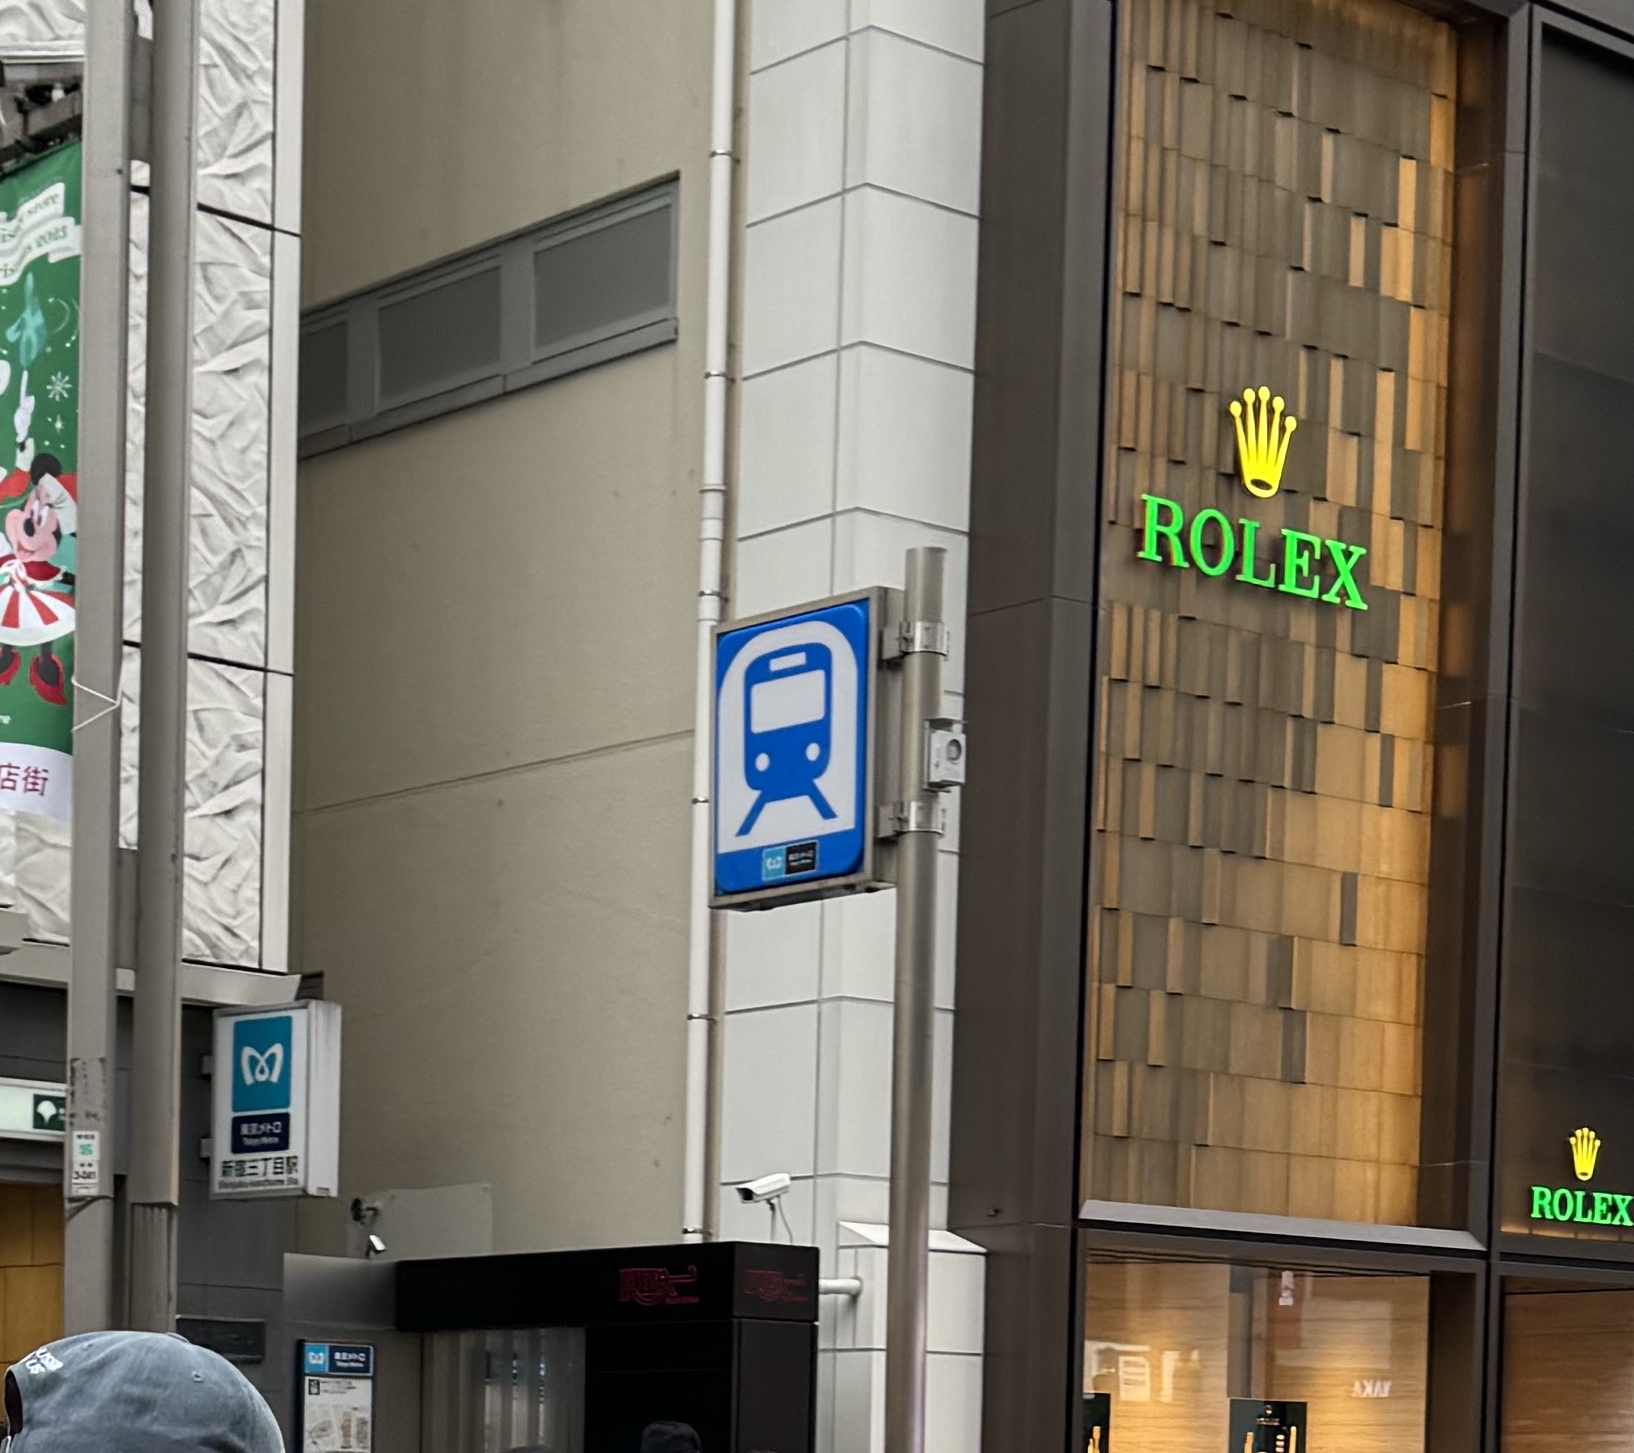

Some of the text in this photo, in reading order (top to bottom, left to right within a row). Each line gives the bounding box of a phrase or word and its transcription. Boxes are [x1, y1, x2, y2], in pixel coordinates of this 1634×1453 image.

[1136, 493, 1369, 610] ROLEX
[222, 1155, 298, 1177] 新宿三丁目駅
[1530, 1185, 1634, 1227] ROLEX
